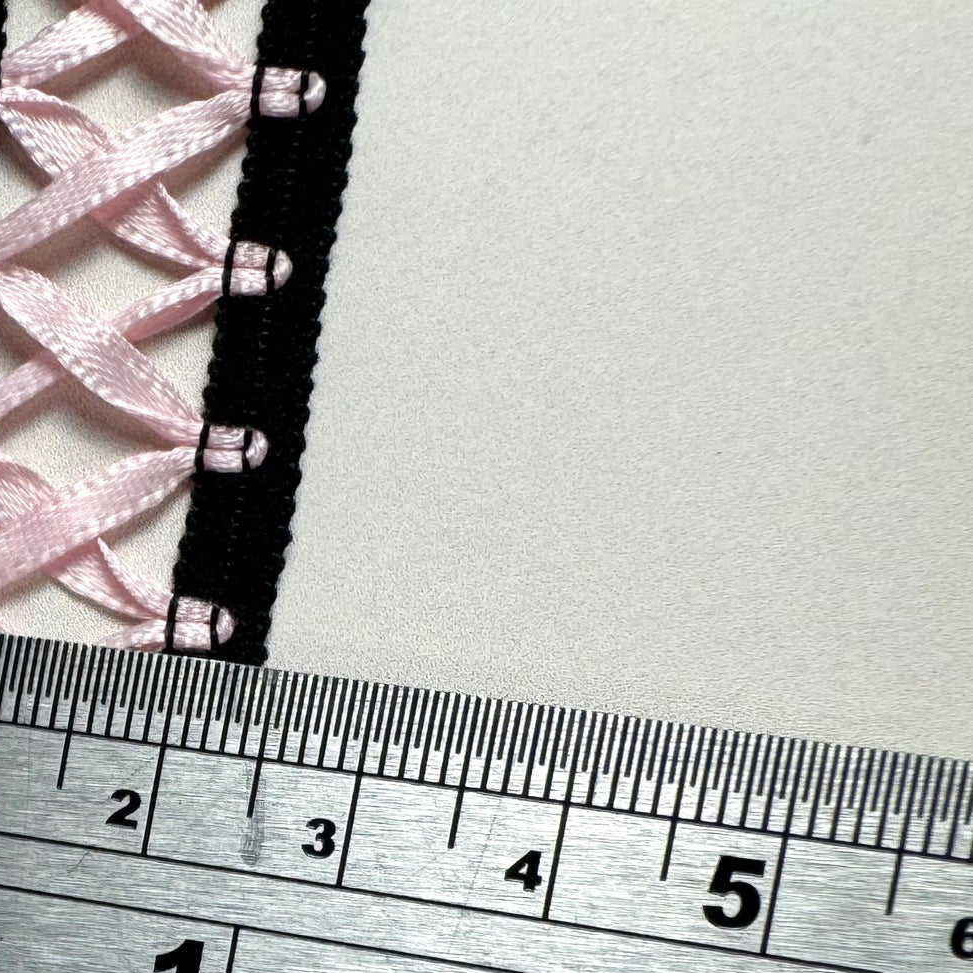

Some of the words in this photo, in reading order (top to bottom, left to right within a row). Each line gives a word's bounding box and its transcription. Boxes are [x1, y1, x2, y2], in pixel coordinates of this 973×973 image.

[105, 789, 142, 830] 2
[301, 818, 336, 859] 3
[504, 850, 543, 891] 4
[703, 855, 766, 929] 5
